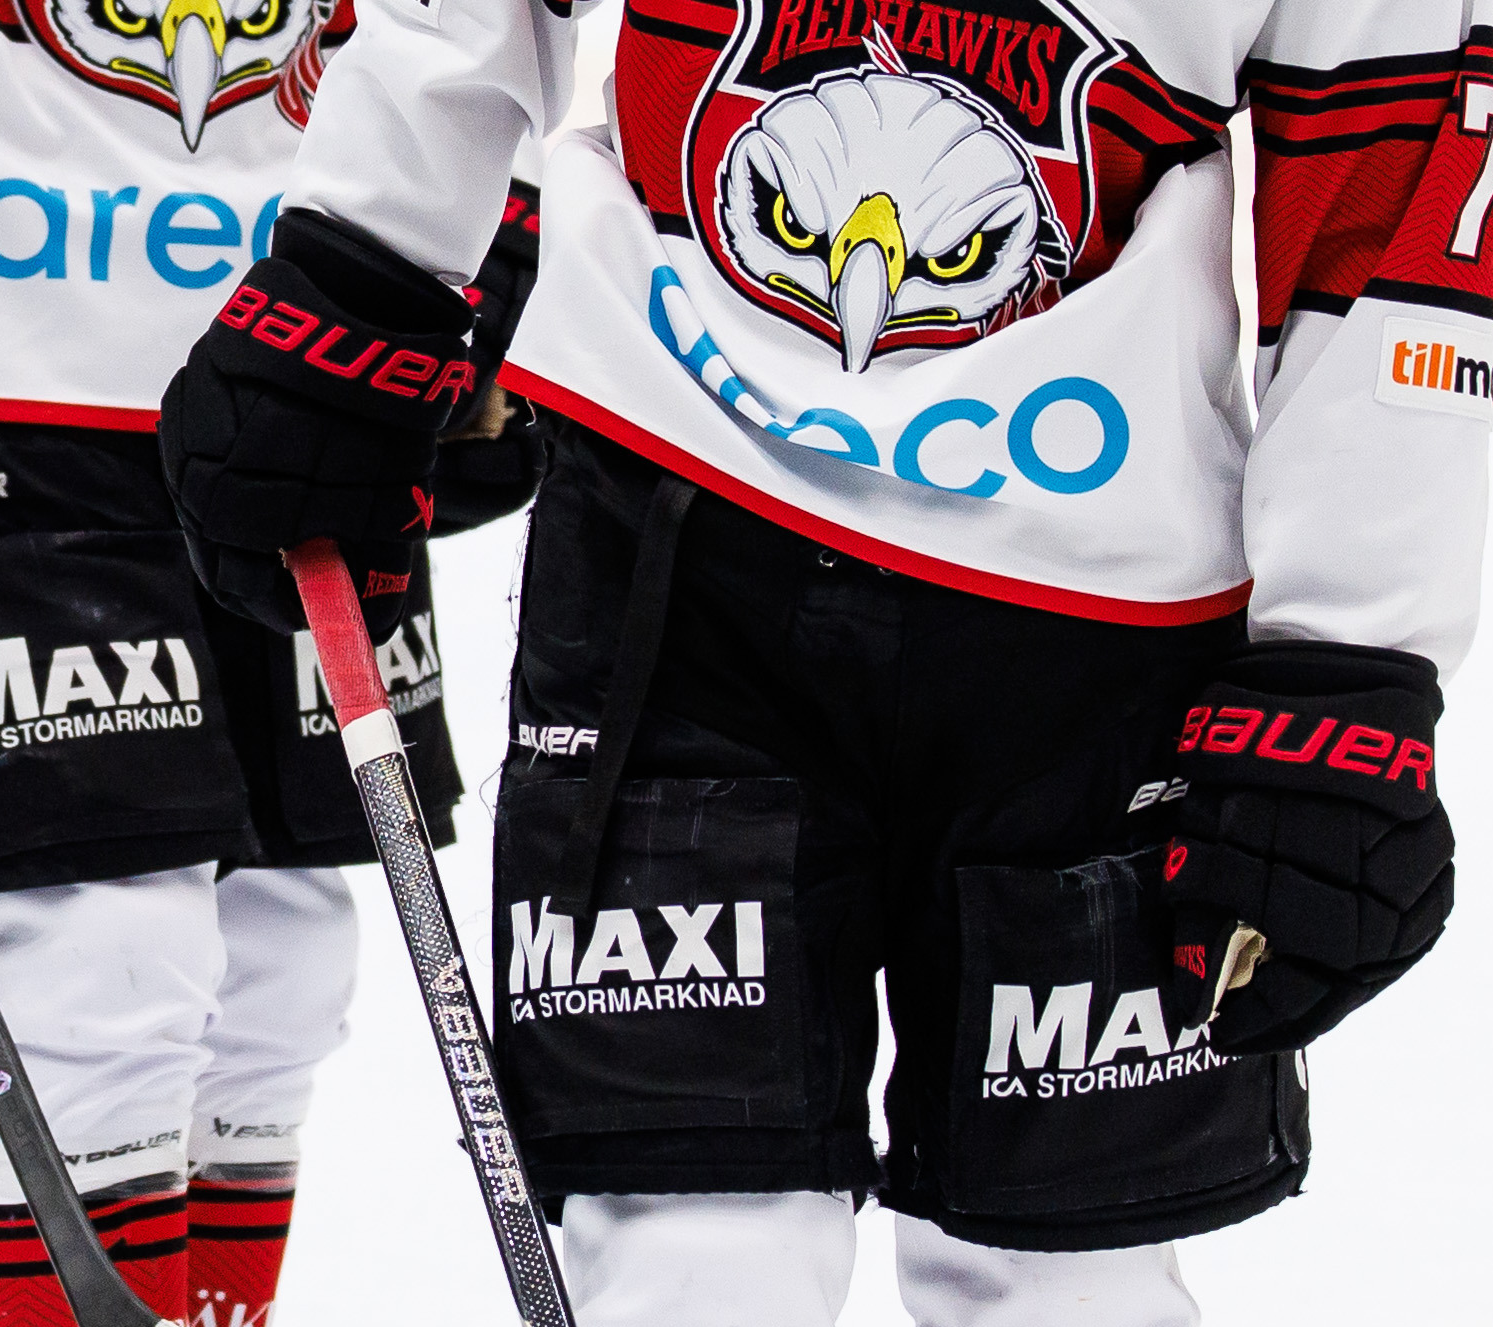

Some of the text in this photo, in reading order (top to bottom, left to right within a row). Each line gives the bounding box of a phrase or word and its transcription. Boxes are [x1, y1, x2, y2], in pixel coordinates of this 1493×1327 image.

[216, 283, 476, 406] BAUER
[0, 702, 204, 751] STORMARKNAD
[1173, 703, 1434, 791] BAUER
[510, 896, 766, 995] MAXI
[539, 982, 766, 1018] STORMARKNAD
[982, 1074, 1029, 1100] ICA
